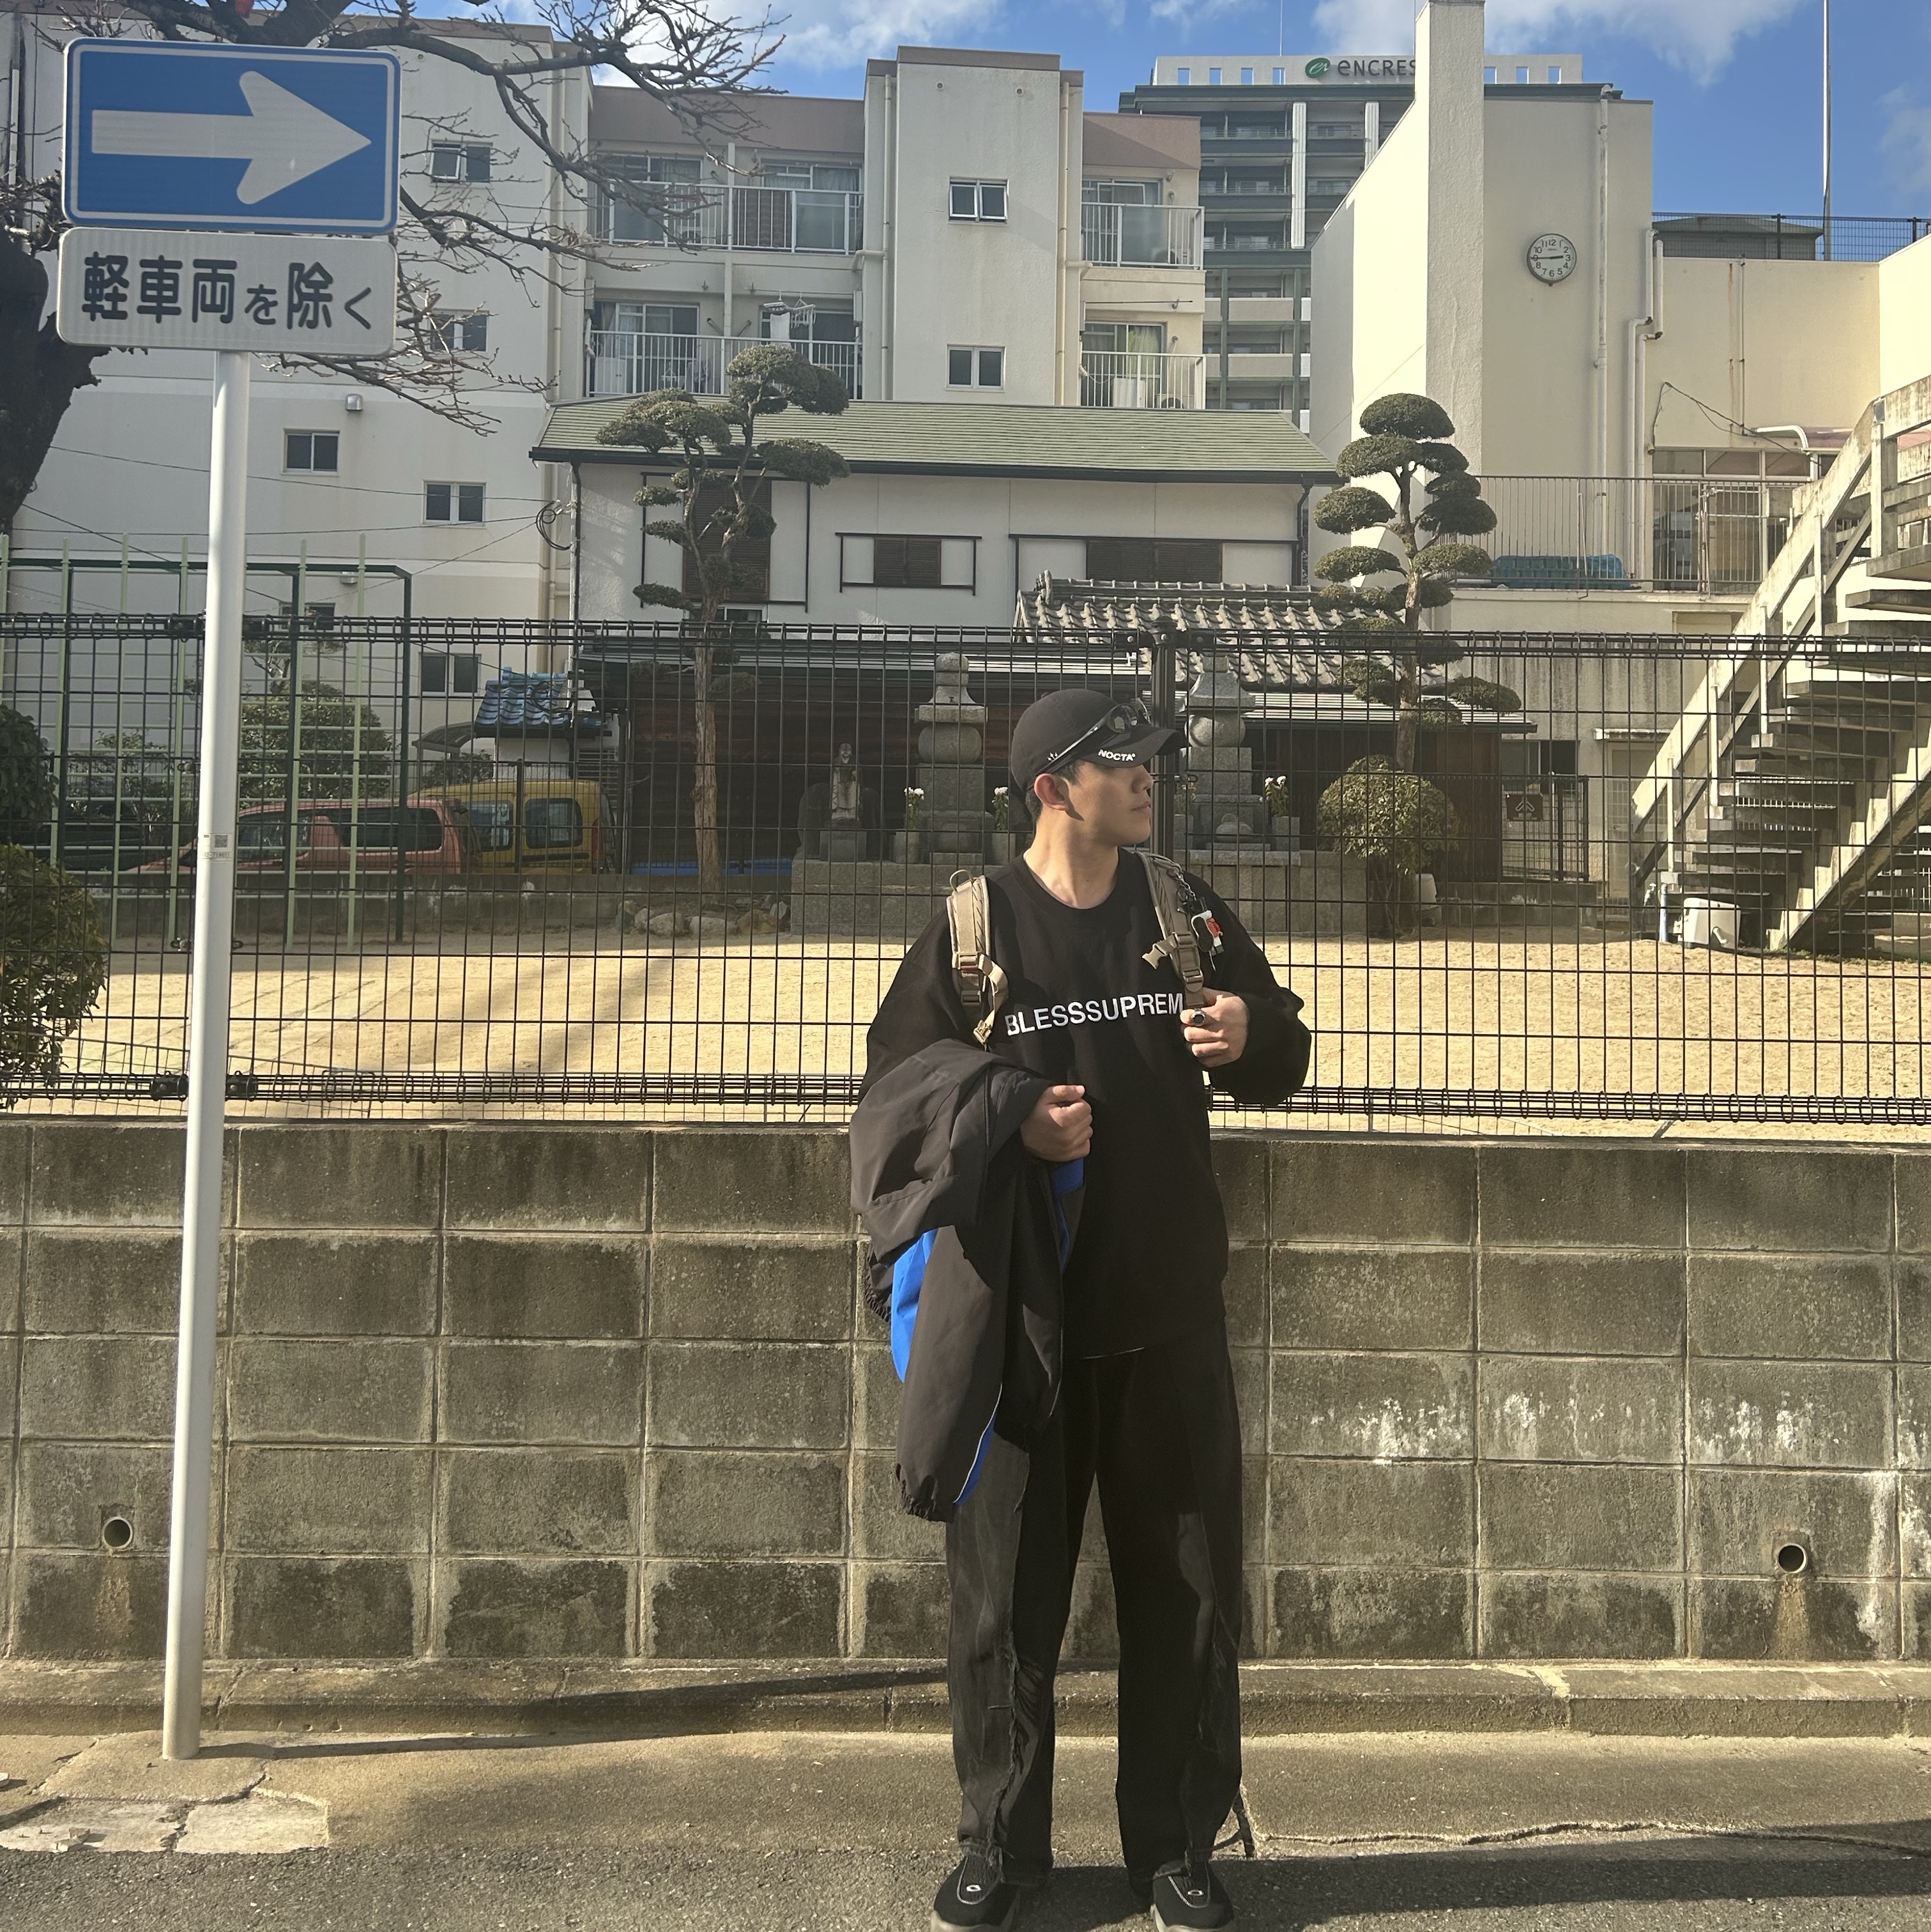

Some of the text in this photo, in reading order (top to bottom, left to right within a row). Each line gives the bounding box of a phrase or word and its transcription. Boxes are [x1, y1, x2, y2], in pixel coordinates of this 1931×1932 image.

[82, 251, 372, 330] 軽車両を除く
[1005, 993, 1183, 1036] BLESSSUPREM
